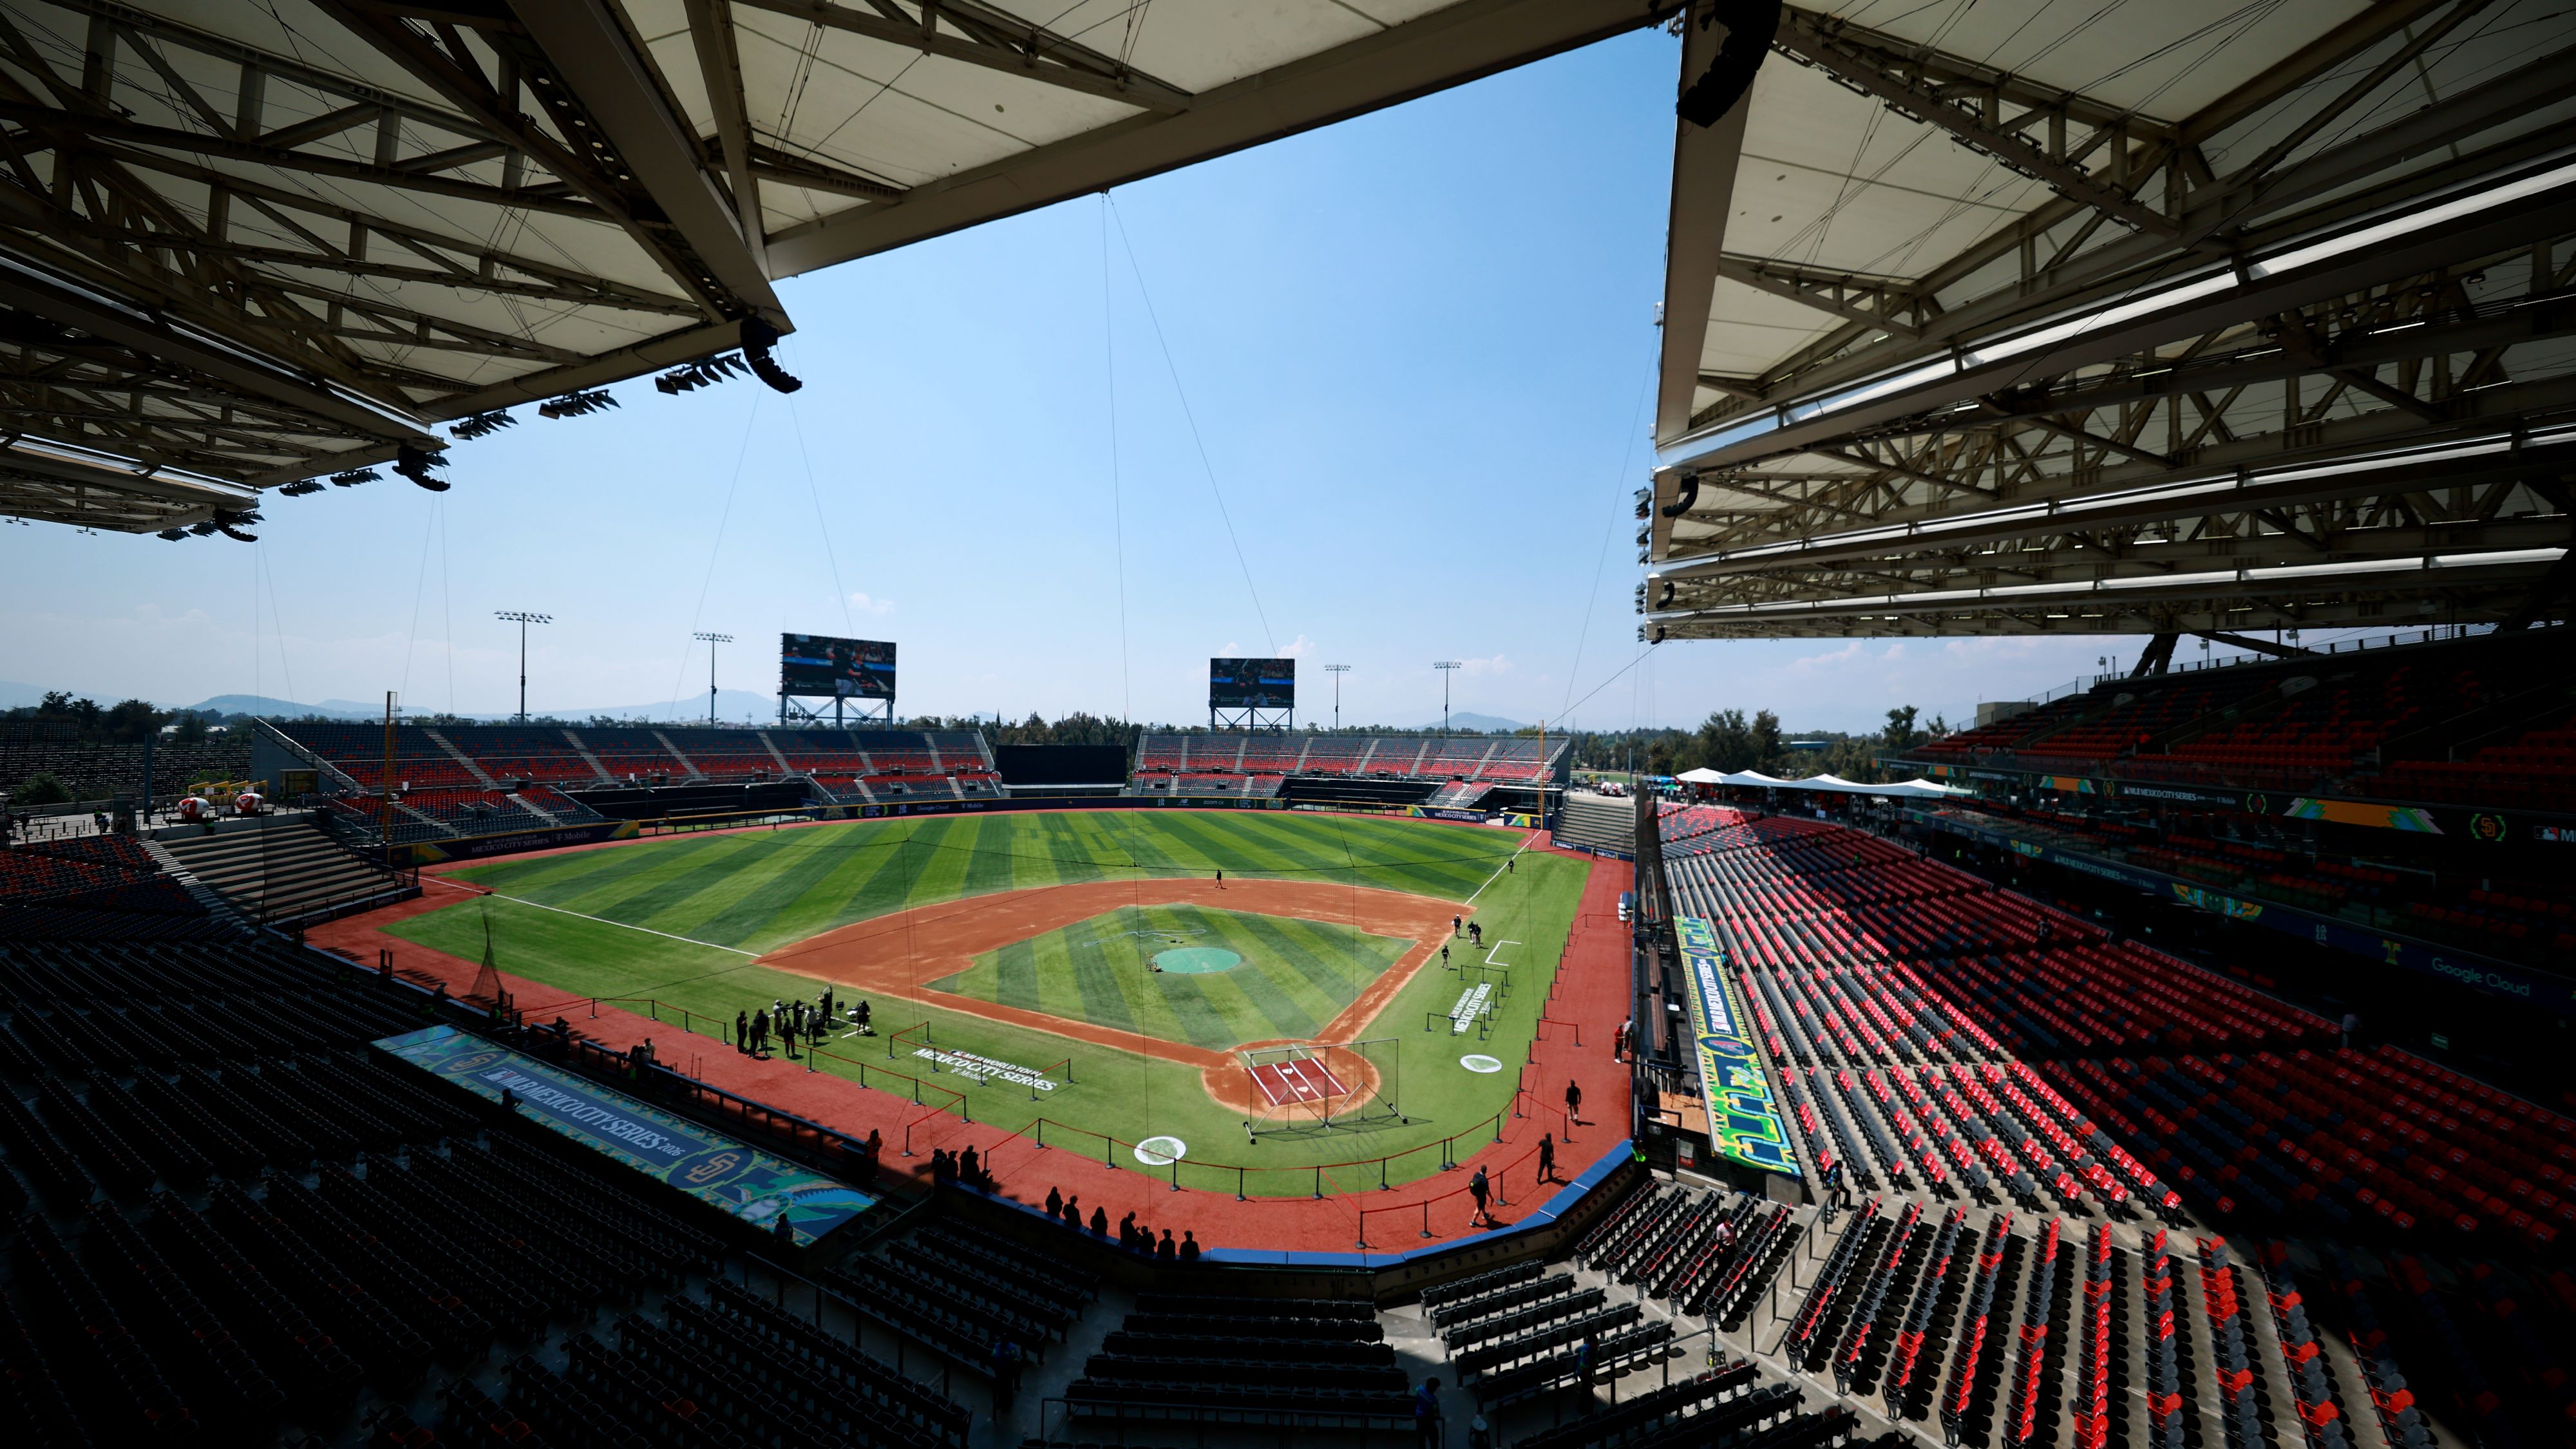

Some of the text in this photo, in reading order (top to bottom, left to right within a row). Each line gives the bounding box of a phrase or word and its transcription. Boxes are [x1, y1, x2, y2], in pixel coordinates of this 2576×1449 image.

[471, 838, 550, 853] MEXICO CITY SERIES
[564, 831, 591, 840] Mobile
[1697, 963, 1715, 980] SERIES
[2432, 957, 2530, 996] Google Cloud
[1454, 983, 1492, 1033] MEXICO CITY SERIES
[1703, 989, 1725, 1011] MEXICO
[912, 1048, 1058, 1091] MEXICO CITY SERIES
[981, 1057, 1018, 1072] WORLD
[497, 1074, 686, 1157] MLB MEXICO CITY SERIES 2026
